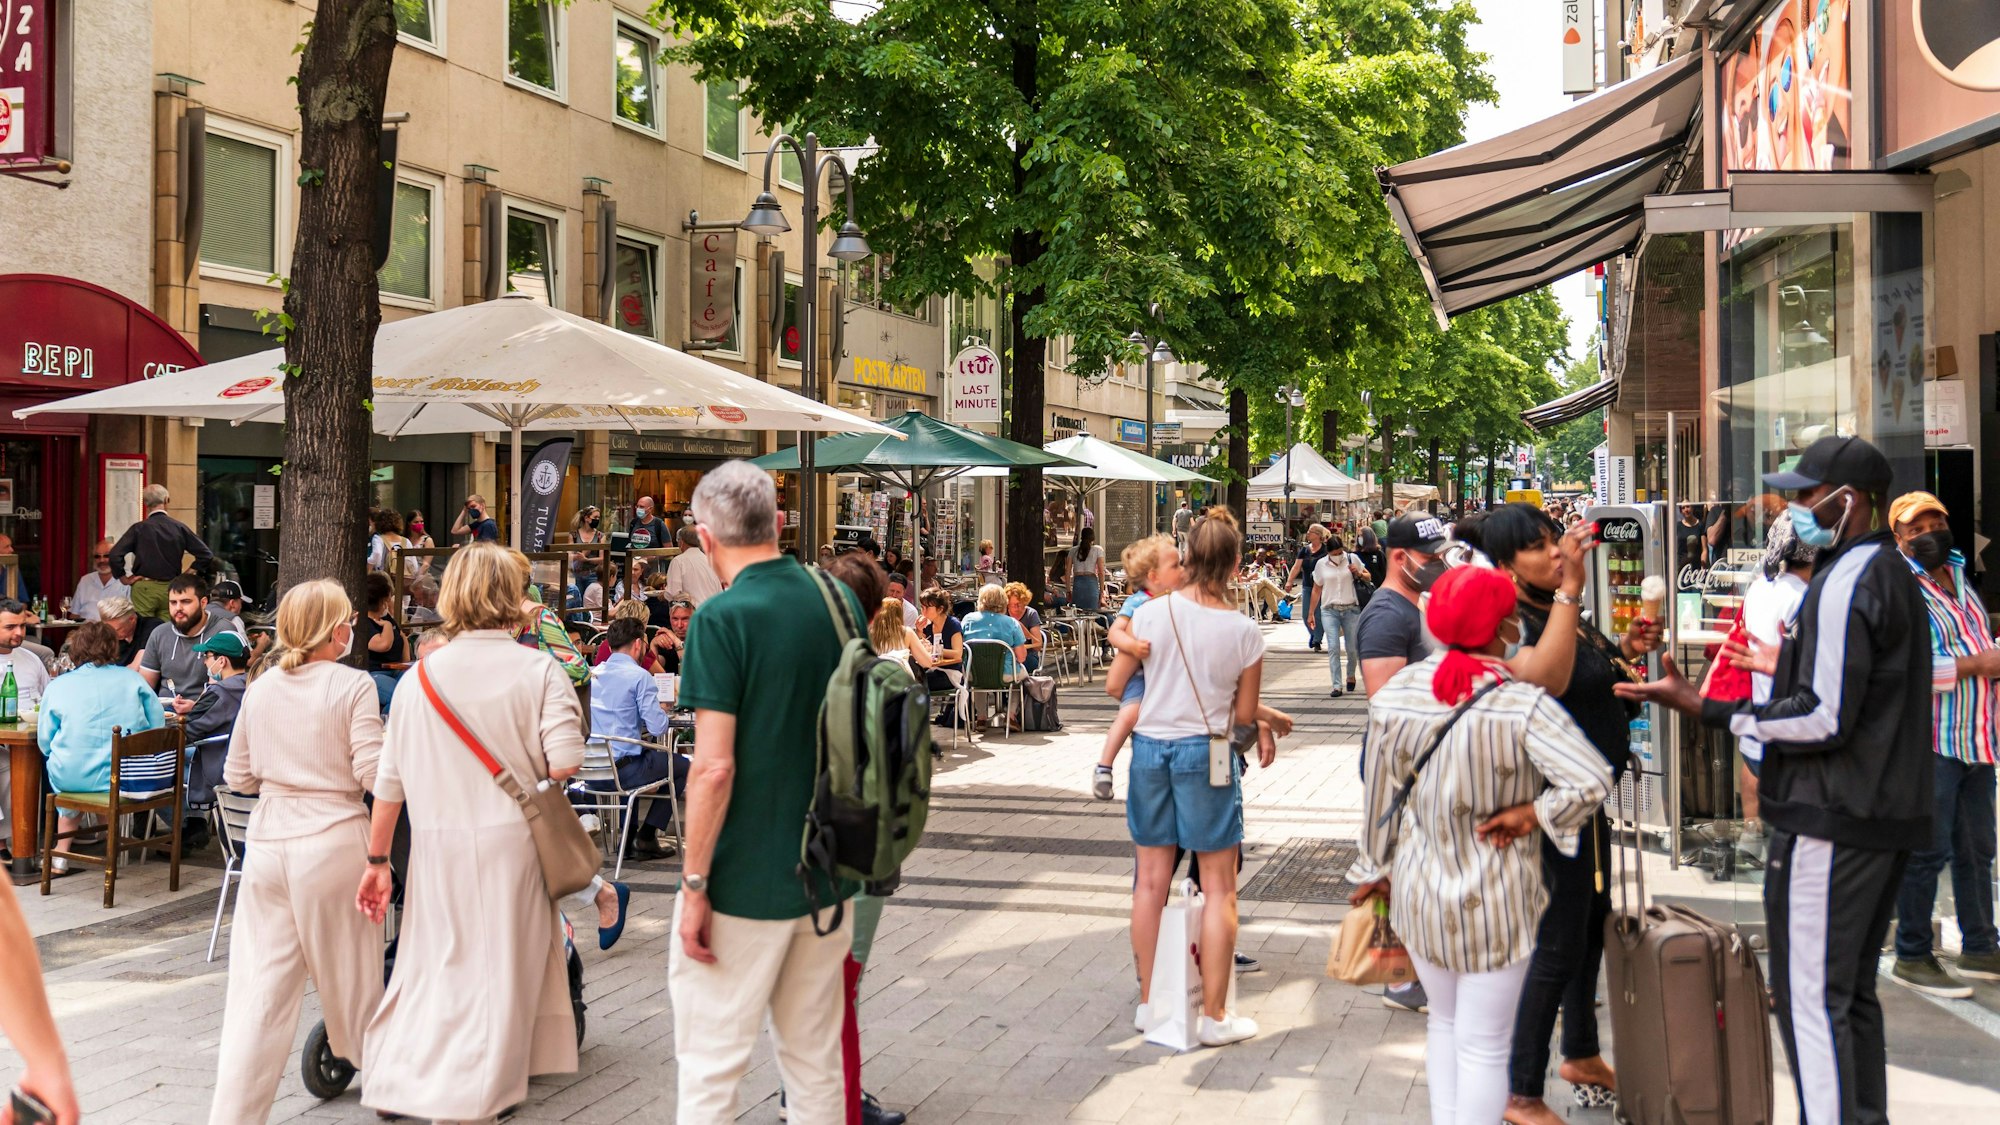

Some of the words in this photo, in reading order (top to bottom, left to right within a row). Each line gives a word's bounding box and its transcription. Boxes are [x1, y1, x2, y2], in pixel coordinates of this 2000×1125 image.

[703, 234, 720, 321] Café
[22, 341, 94, 379] BEPI
[853, 356, 927, 393] POSTKARTEN
[955, 398, 998, 409] MINUTE
[962, 384, 990, 395] LAST
[1618, 458, 1626, 504] TESTZENTRUM
